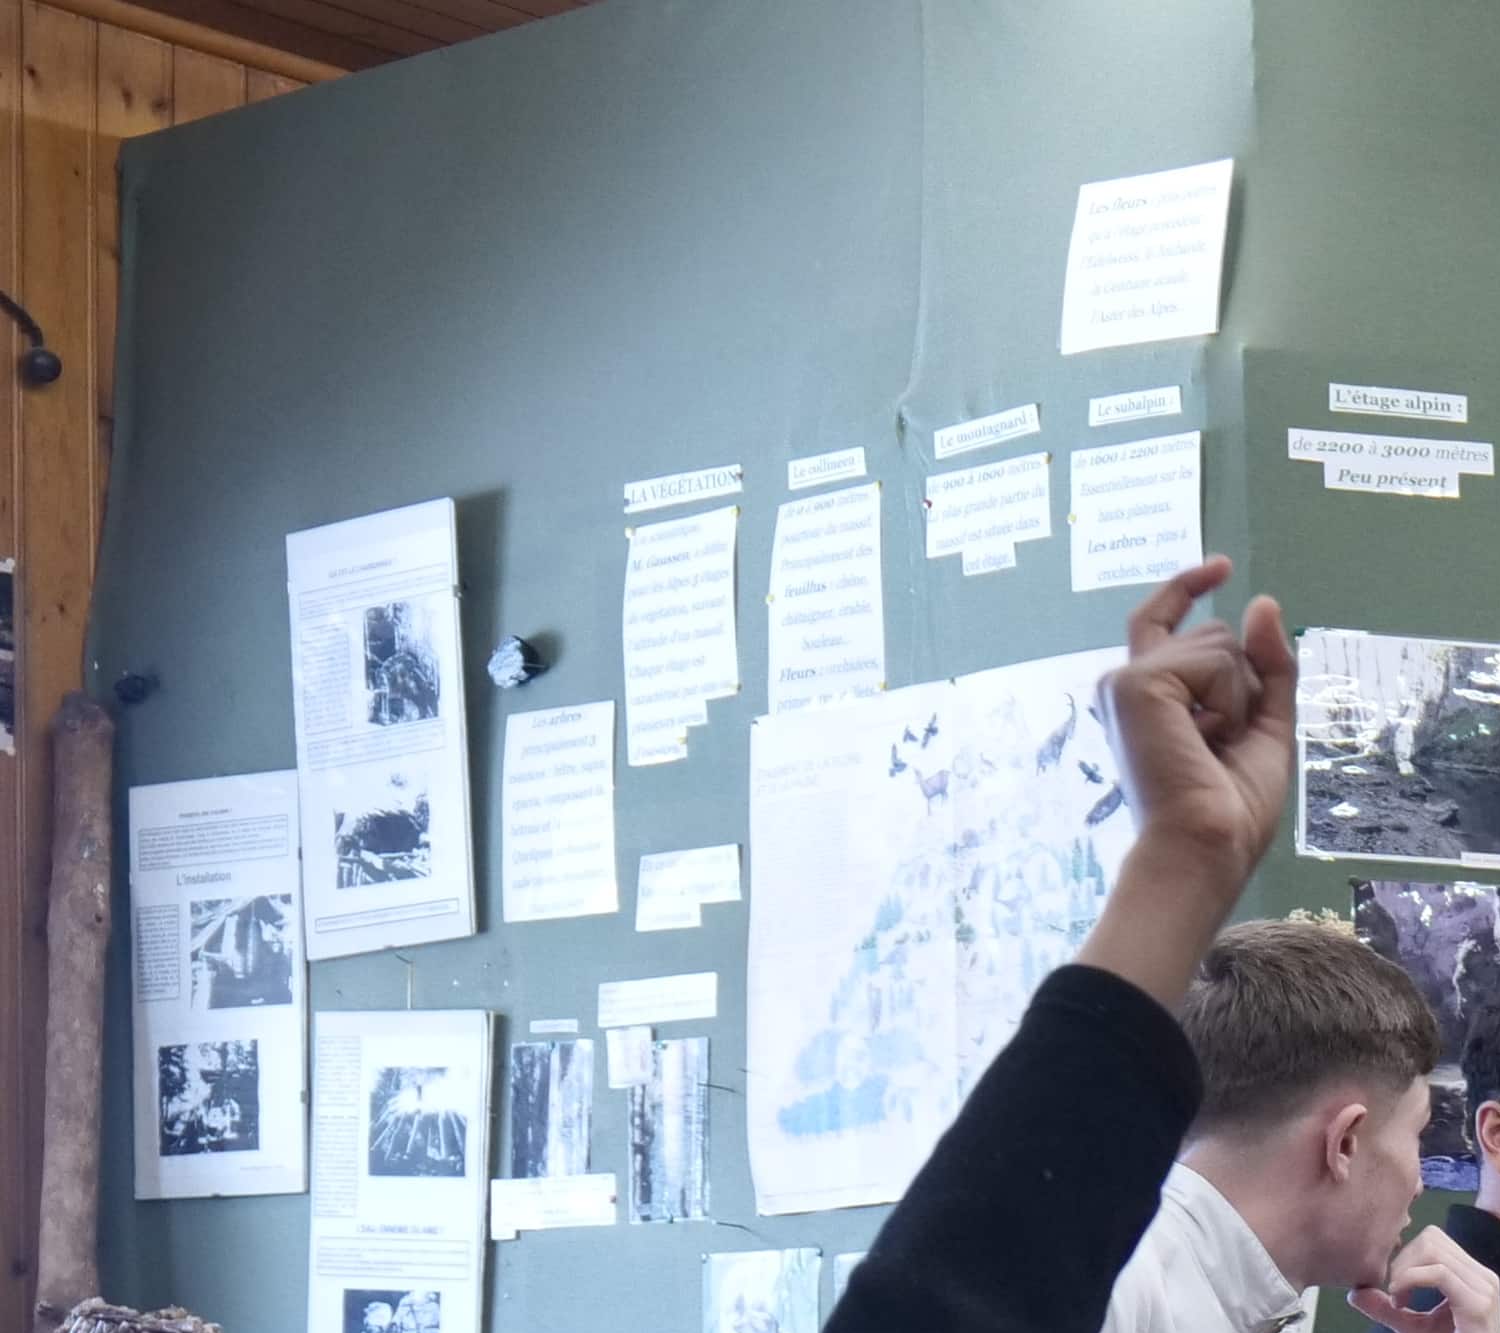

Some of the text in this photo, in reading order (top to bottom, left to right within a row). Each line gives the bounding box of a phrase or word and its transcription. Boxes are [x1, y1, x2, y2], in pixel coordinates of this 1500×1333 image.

[1334, 389, 1452, 413] L'étage alpin
[1292, 437, 1489, 461] de 2200 à 3000 mètres
[1338, 469, 1447, 489] Peu présent
